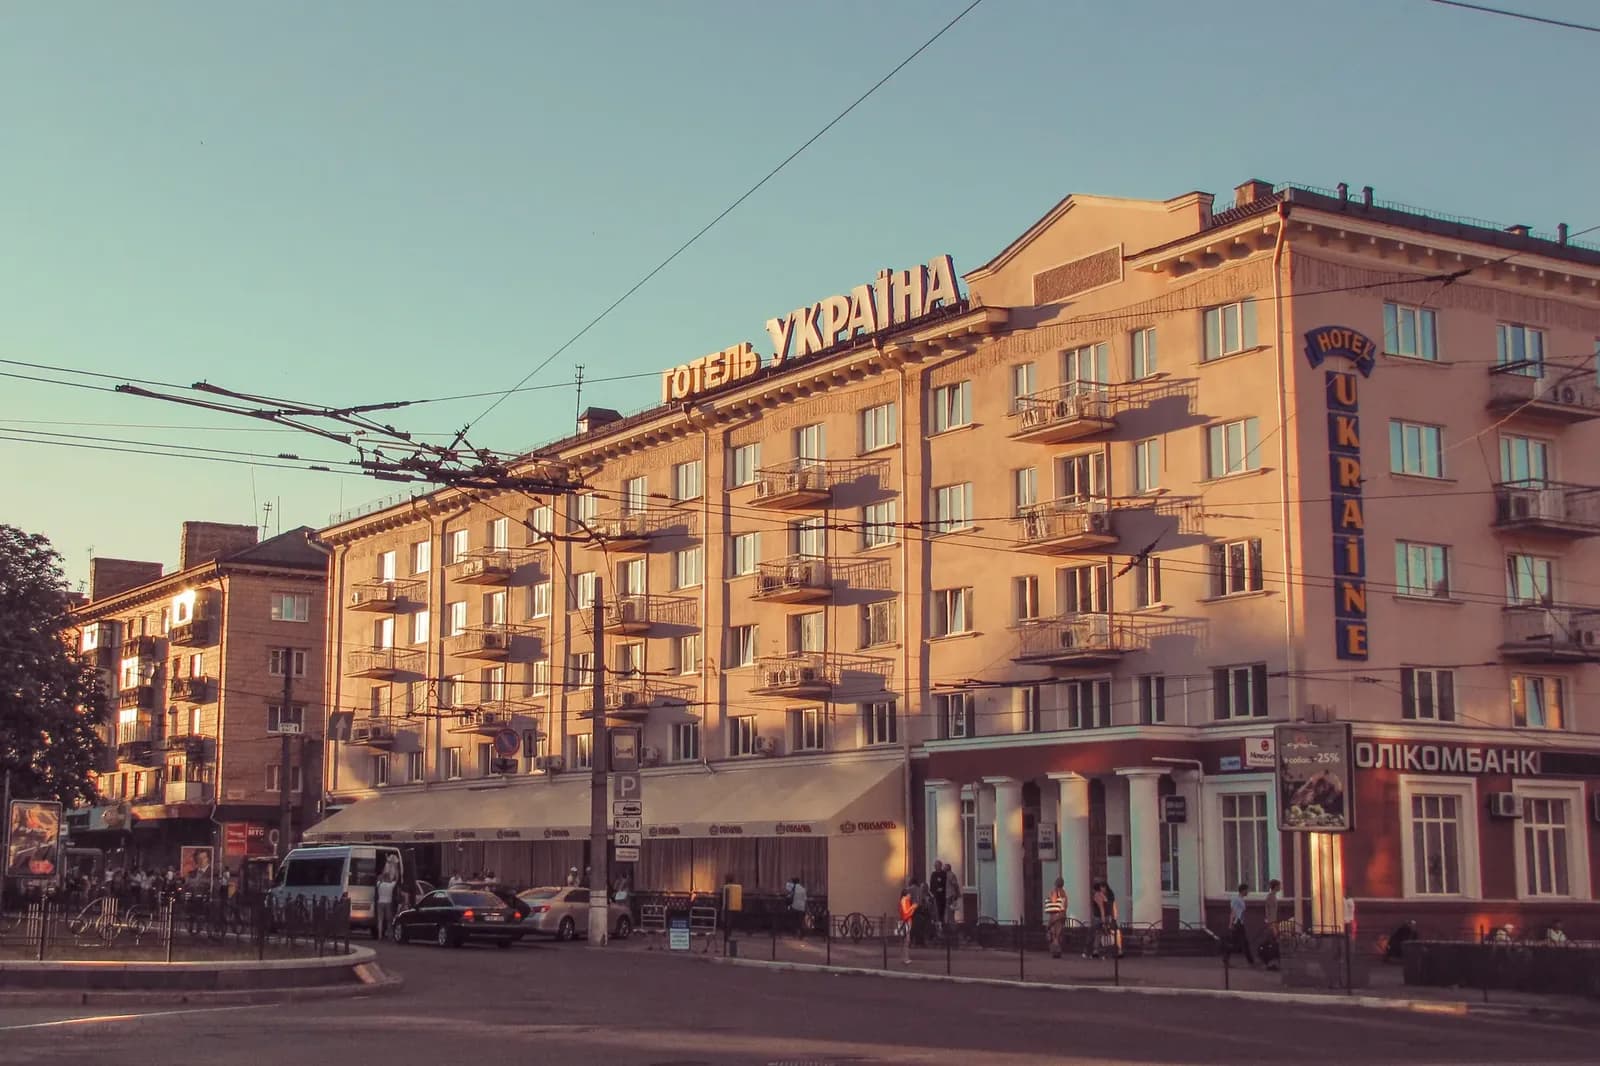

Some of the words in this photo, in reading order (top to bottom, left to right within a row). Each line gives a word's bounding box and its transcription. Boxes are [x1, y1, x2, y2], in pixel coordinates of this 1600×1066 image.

[766, 254, 961, 368] УКРАЇНА
[1317, 328, 1375, 361] HOTEL
[661, 342, 761, 403] ГОТЕЛЬ
[619, 835, 629, 844] 20
